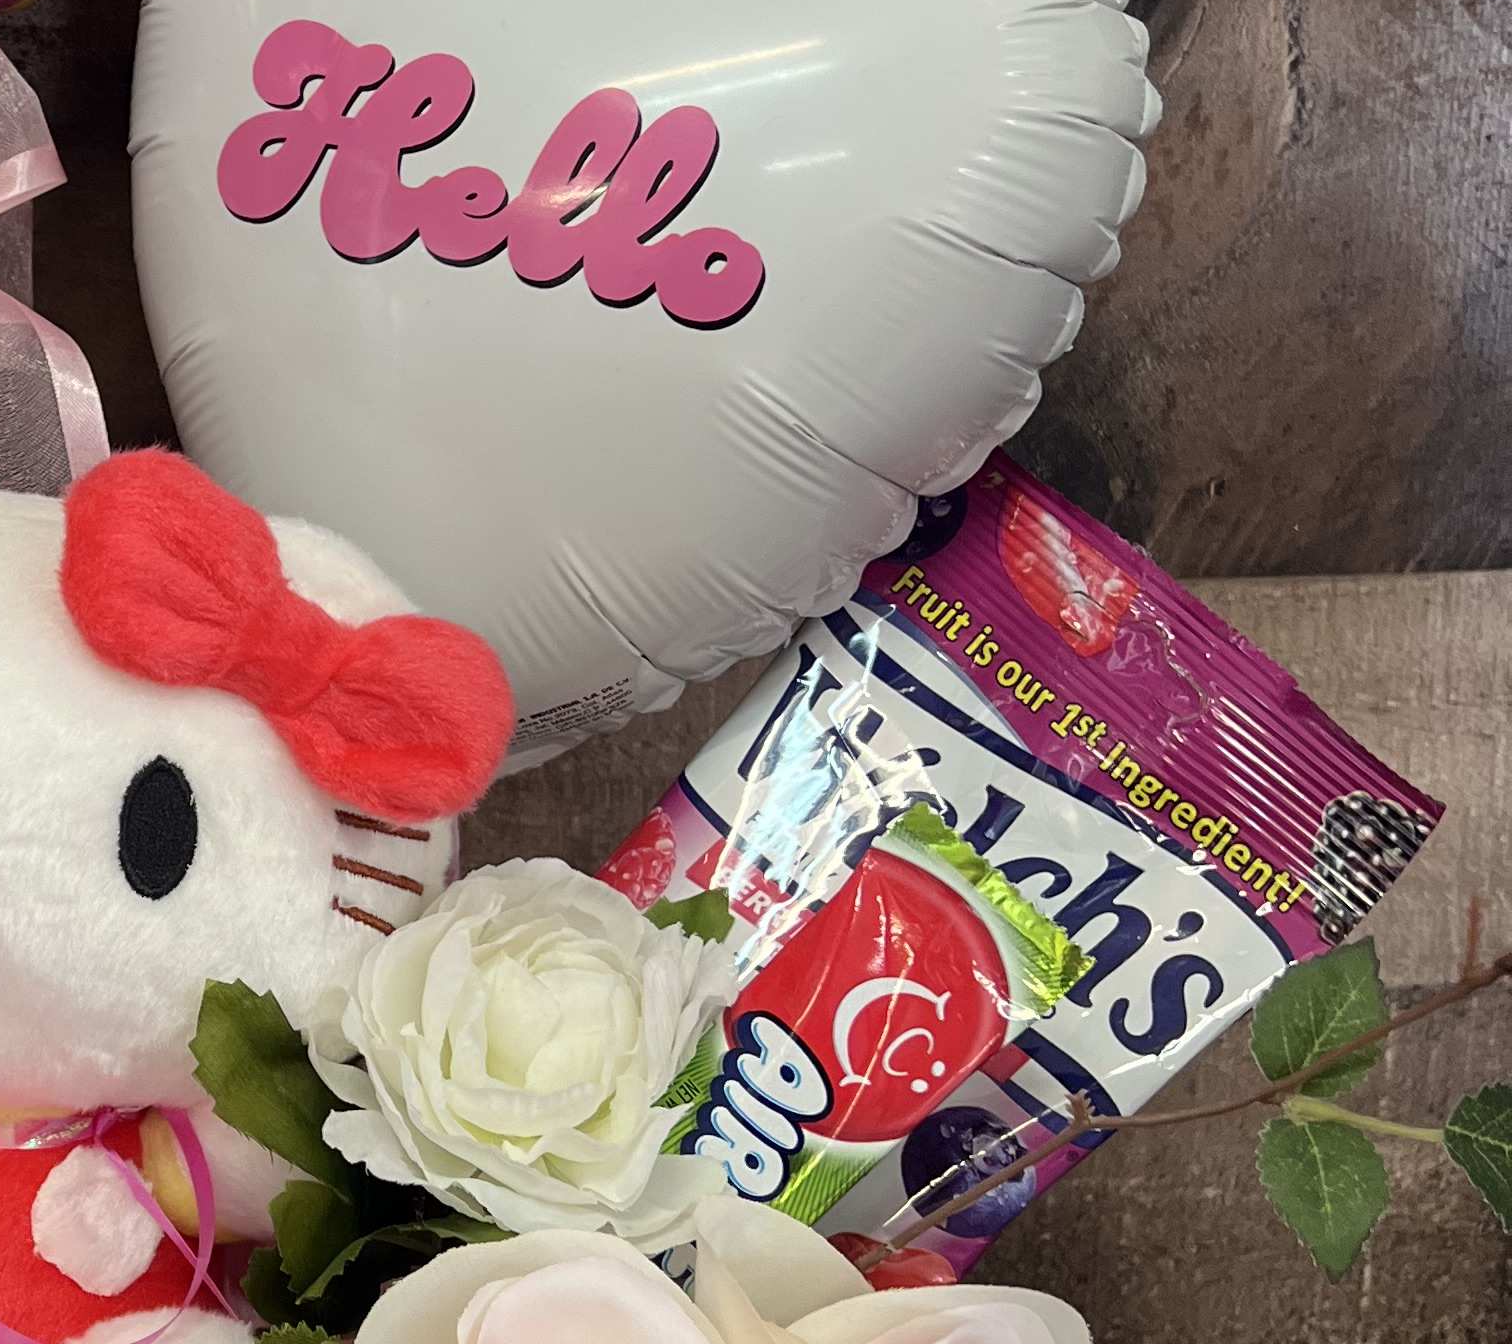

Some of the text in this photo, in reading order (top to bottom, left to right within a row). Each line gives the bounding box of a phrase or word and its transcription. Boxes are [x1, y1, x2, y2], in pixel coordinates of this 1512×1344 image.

[217, 19, 765, 330] Hello
[890, 565, 1306, 913] Fruit is our 1st Ingredient!
